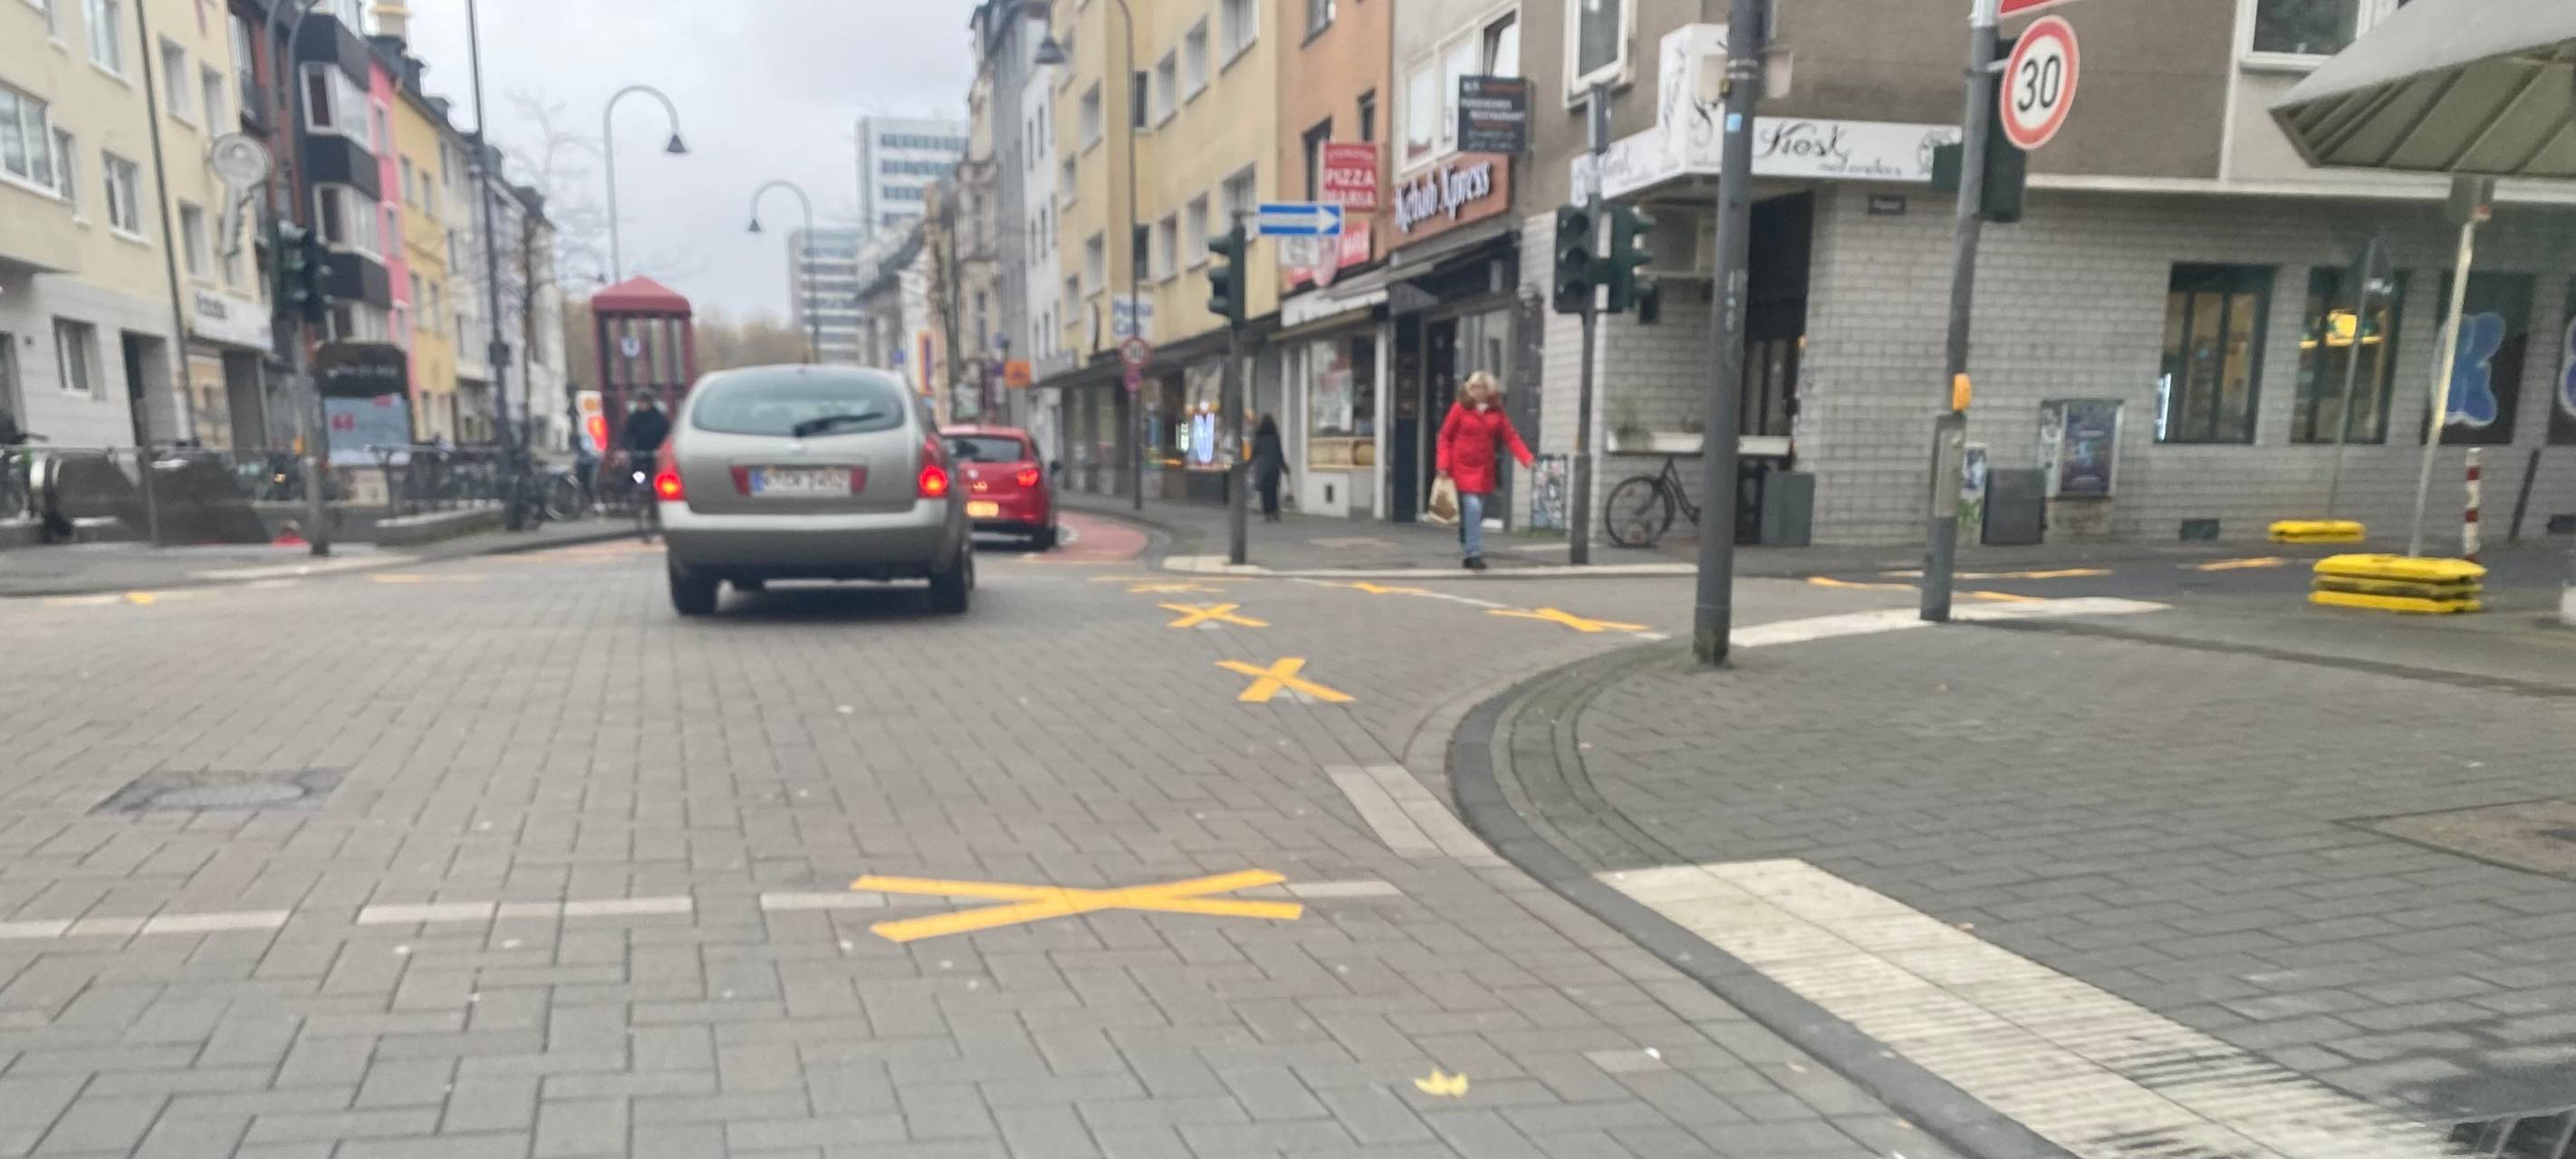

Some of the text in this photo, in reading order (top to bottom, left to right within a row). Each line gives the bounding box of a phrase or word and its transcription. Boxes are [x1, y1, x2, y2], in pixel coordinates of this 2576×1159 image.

[2017, 54, 2062, 111] 30
[1754, 120, 1851, 159] Kiosk
[1326, 168, 1375, 186] PIZZA
[1395, 171, 1437, 233] Kebab
